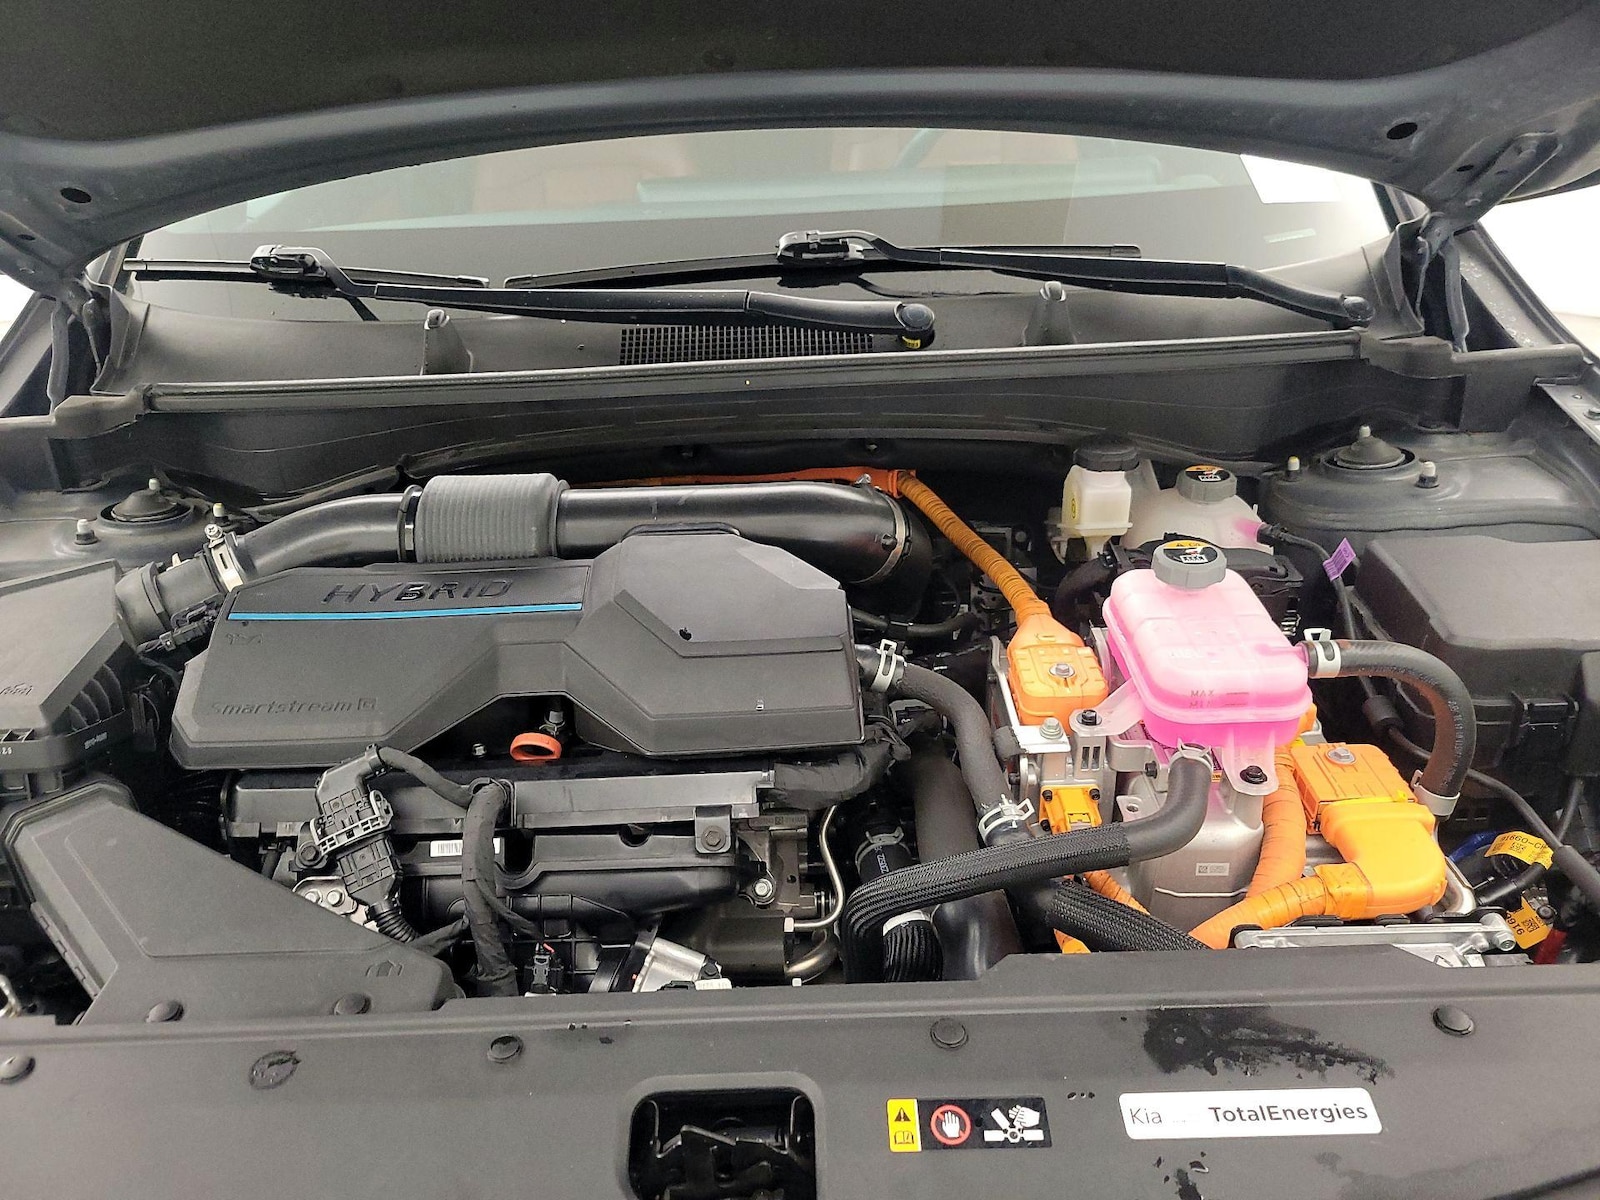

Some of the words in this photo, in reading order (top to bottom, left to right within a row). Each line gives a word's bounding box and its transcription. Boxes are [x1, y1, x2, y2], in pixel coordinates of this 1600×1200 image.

[320, 578, 513, 604] HYBRID
[1190, 689, 1214, 698] MAX
[1129, 1107, 1162, 1125] Kia
[1208, 1103, 1368, 1123] TotalEnergies
